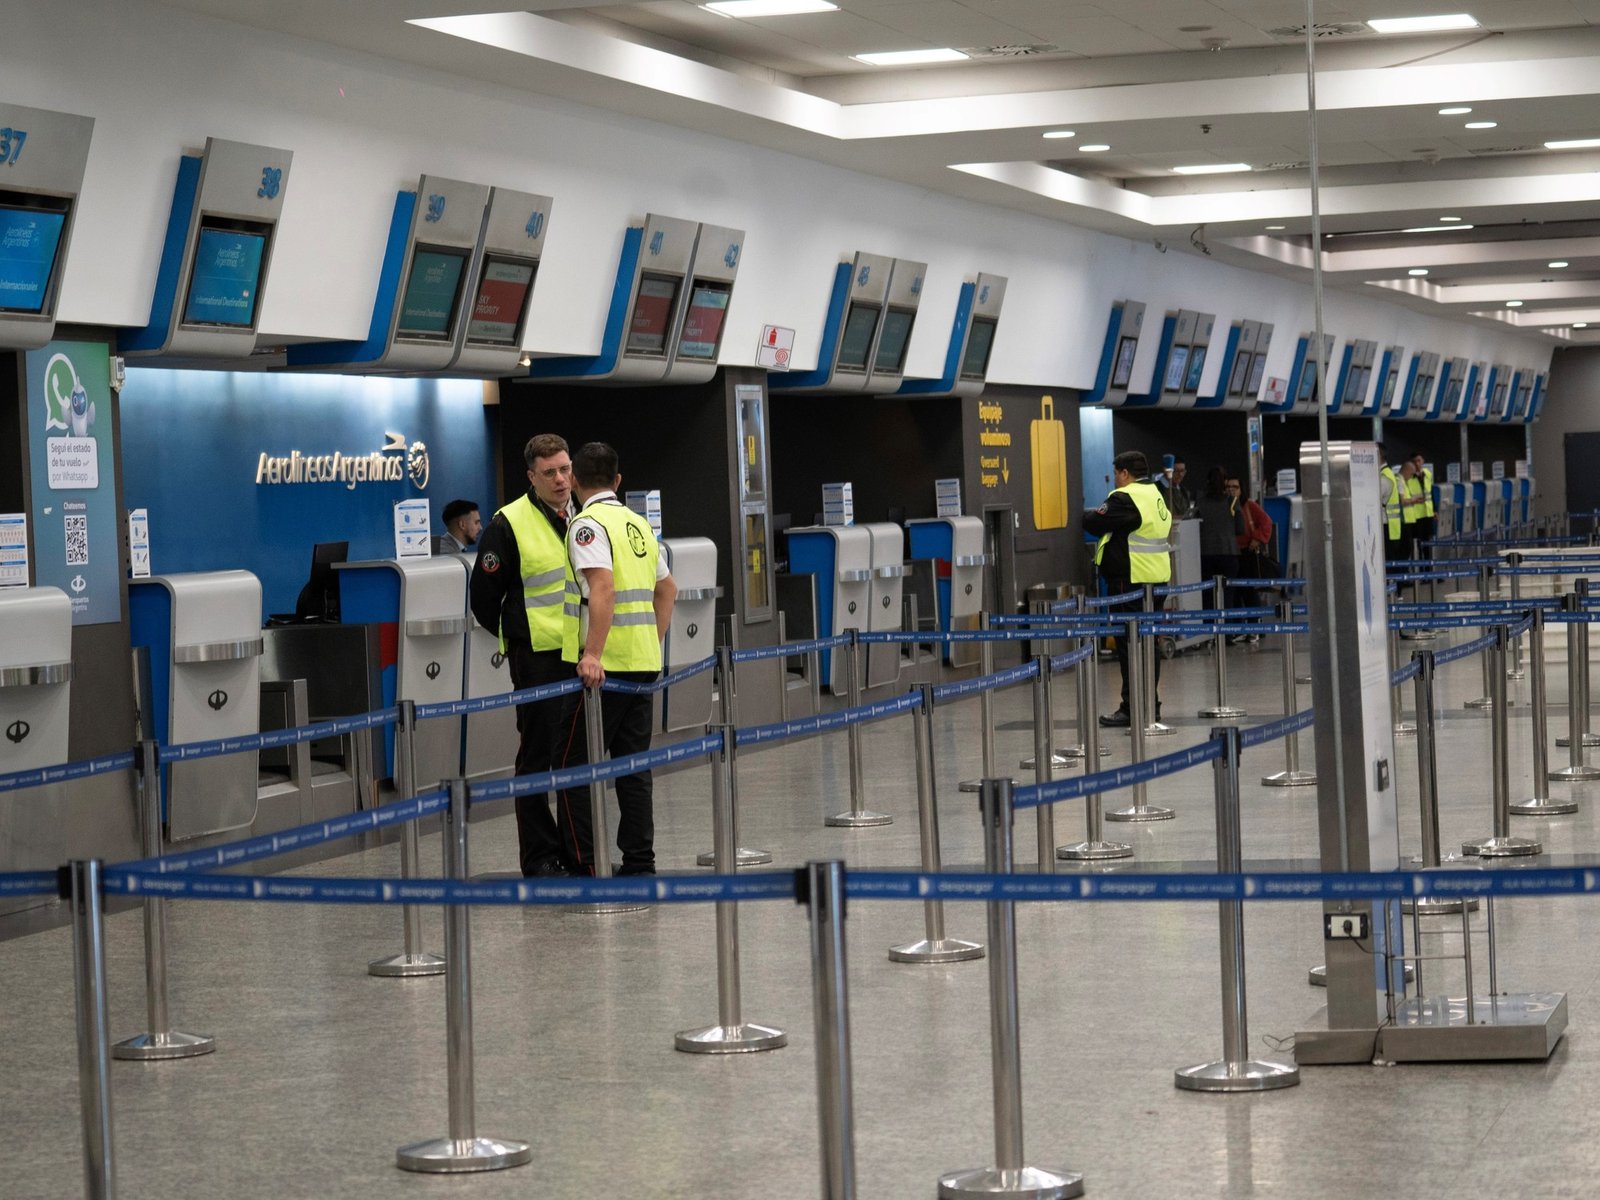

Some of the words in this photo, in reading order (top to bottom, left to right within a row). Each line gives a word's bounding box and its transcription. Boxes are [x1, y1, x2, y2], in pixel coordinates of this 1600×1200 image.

[0, 127, 28, 168] 37
[257, 167, 282, 199] 38
[425, 194, 446, 223] 39
[525, 211, 544, 240] 40
[73, 443, 91, 453] estado
[51, 457, 59, 467] de
[66, 457, 82, 467] vuelo
[673, 884, 723, 896] despegar
[937, 881, 994, 895] despegar
[1100, 880, 1158, 895] despegar
[1264, 880, 1323, 894] despegar
[1433, 877, 1492, 891] despegar
[399, 886, 446, 898] despegar
[534, 886, 582, 898] despegar
